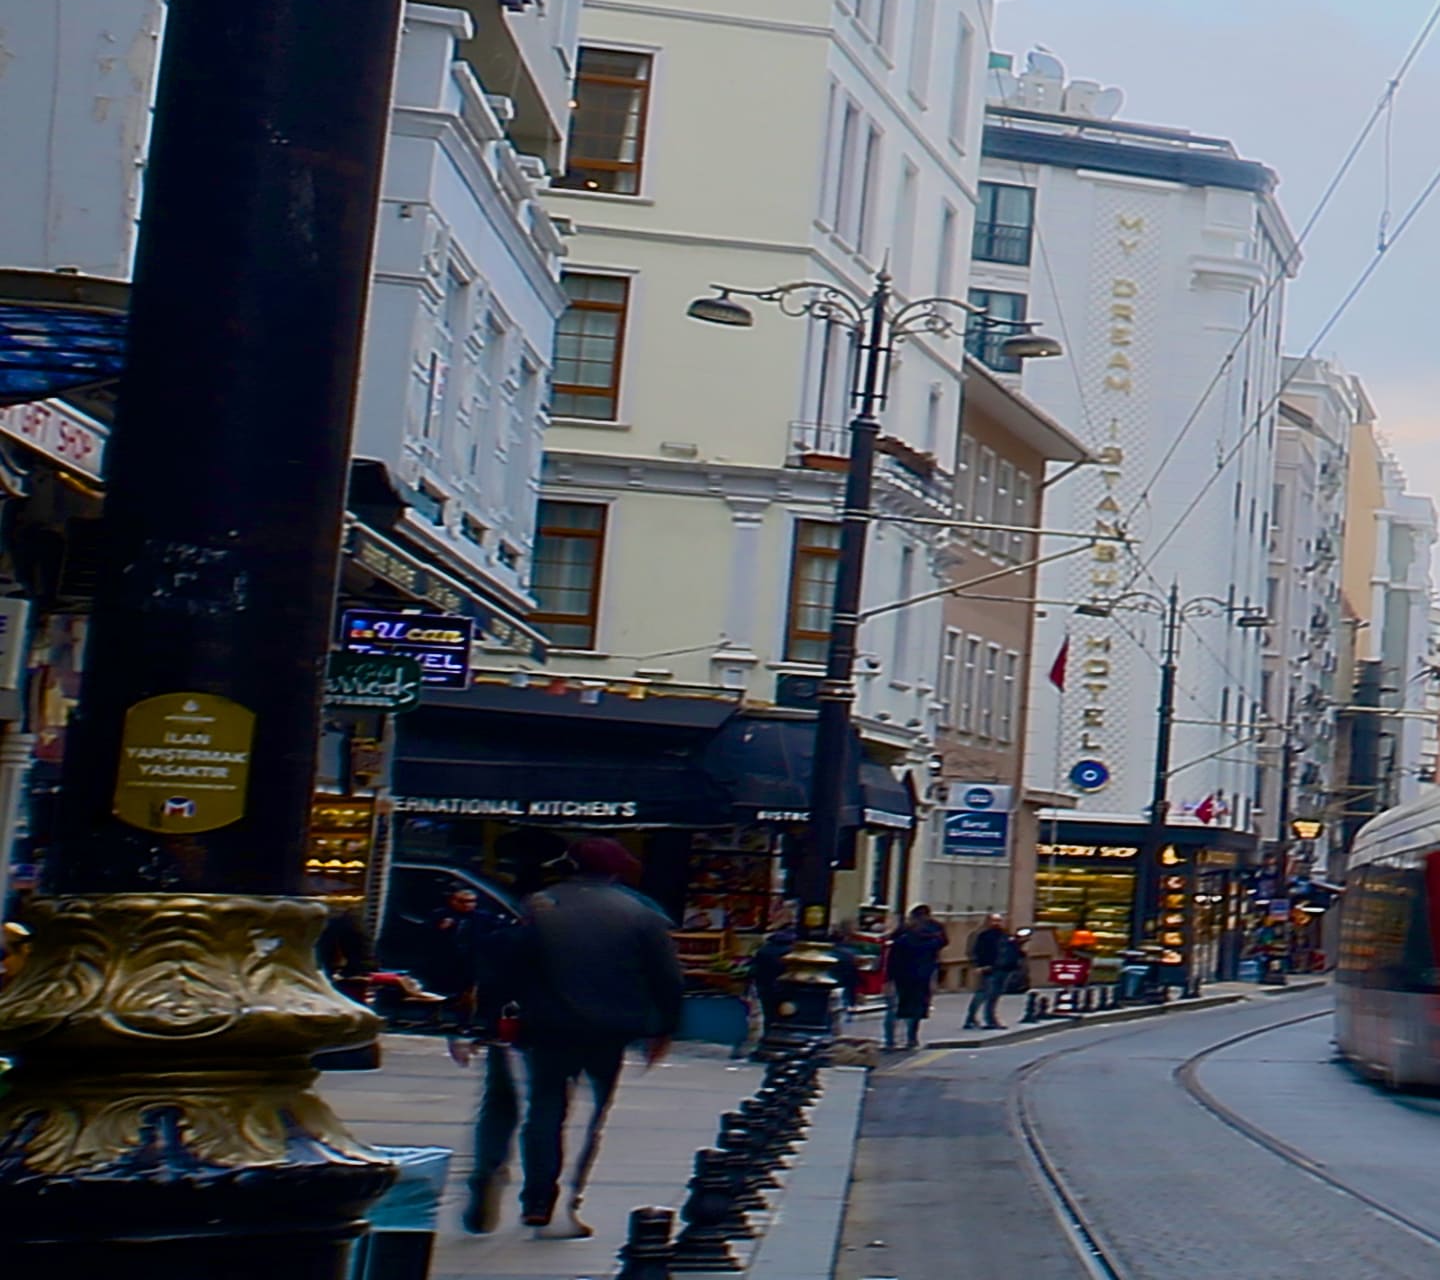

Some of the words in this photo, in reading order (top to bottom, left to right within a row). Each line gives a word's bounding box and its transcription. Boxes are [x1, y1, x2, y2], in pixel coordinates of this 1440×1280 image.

[1104, 277, 1139, 394] DREAM
[1081, 634, 1111, 751] HOTEL
[393, 797, 524, 816] ERNATIONAL
[527, 800, 637, 818] KITCHEN'S
